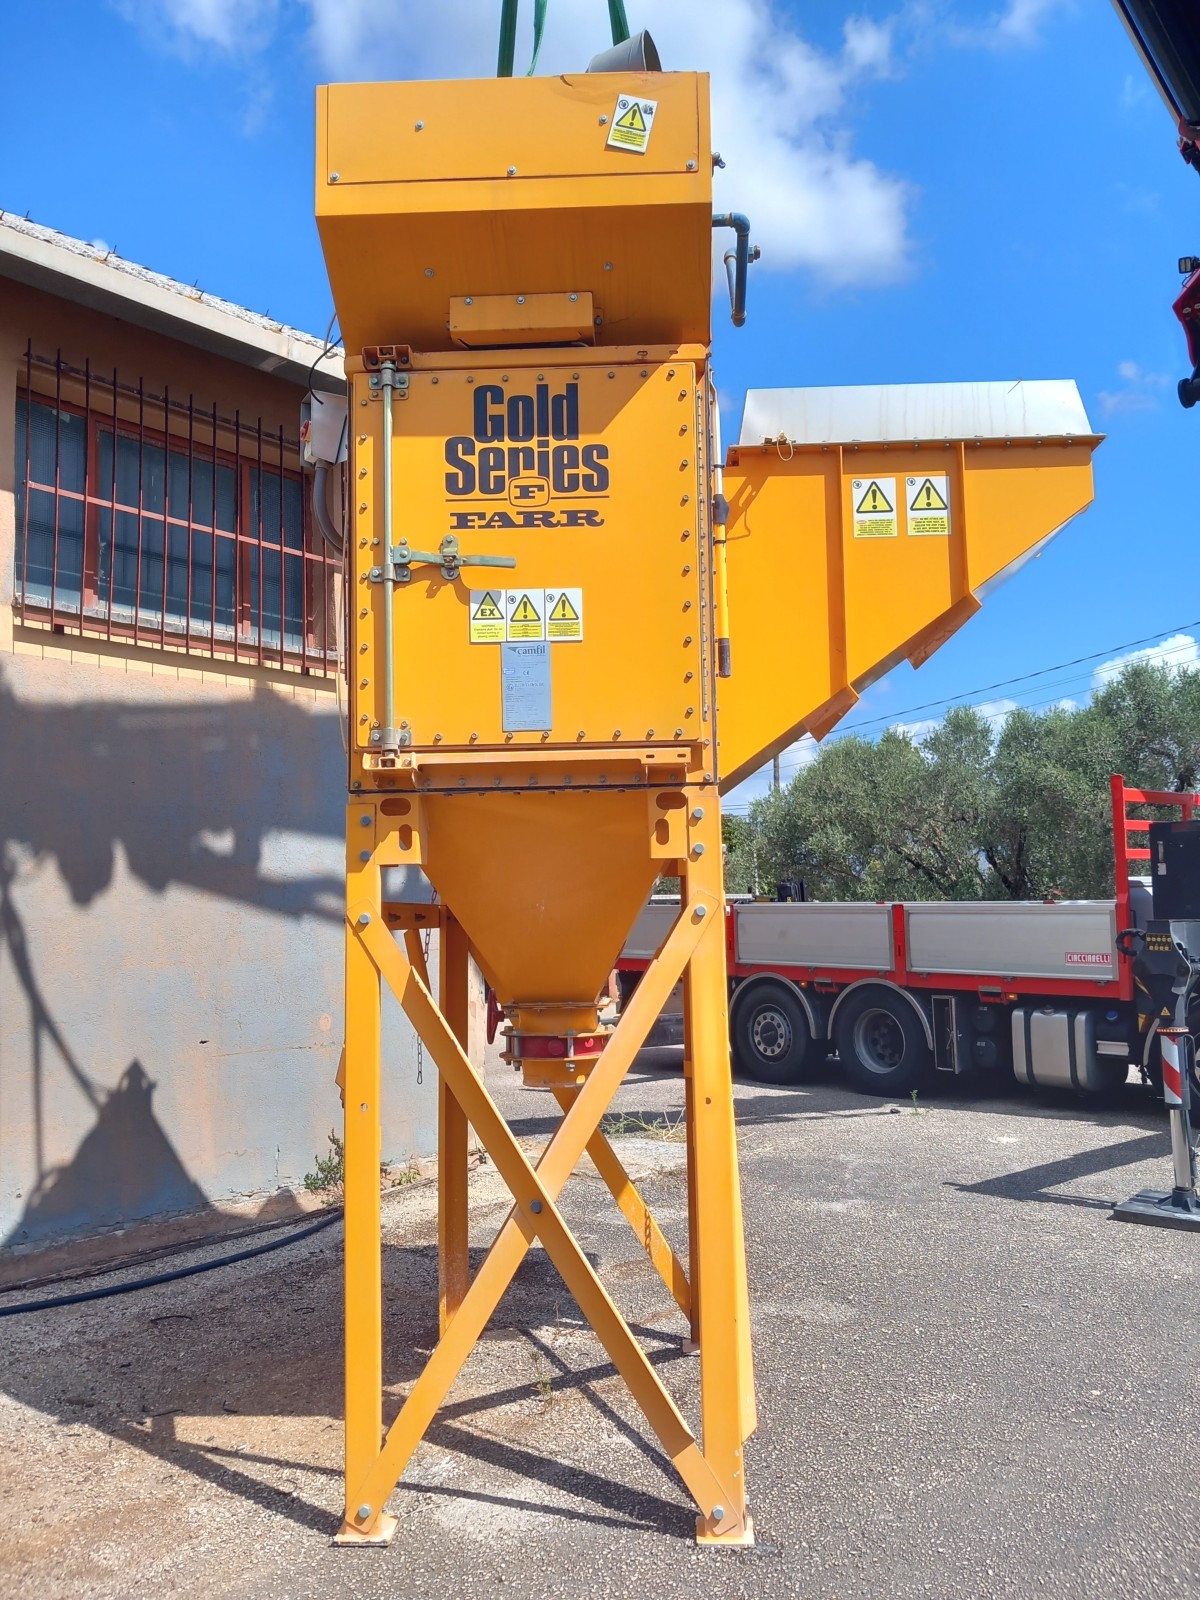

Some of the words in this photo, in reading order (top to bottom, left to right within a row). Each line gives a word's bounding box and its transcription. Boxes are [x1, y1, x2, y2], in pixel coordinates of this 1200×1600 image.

[473, 383, 579, 443] Gold
[445, 436, 609, 495] Series
[514, 485, 544, 499] F
[450, 510, 605, 529] FARR
[480, 608, 496, 617] EX
[517, 645, 546, 655] camfil
